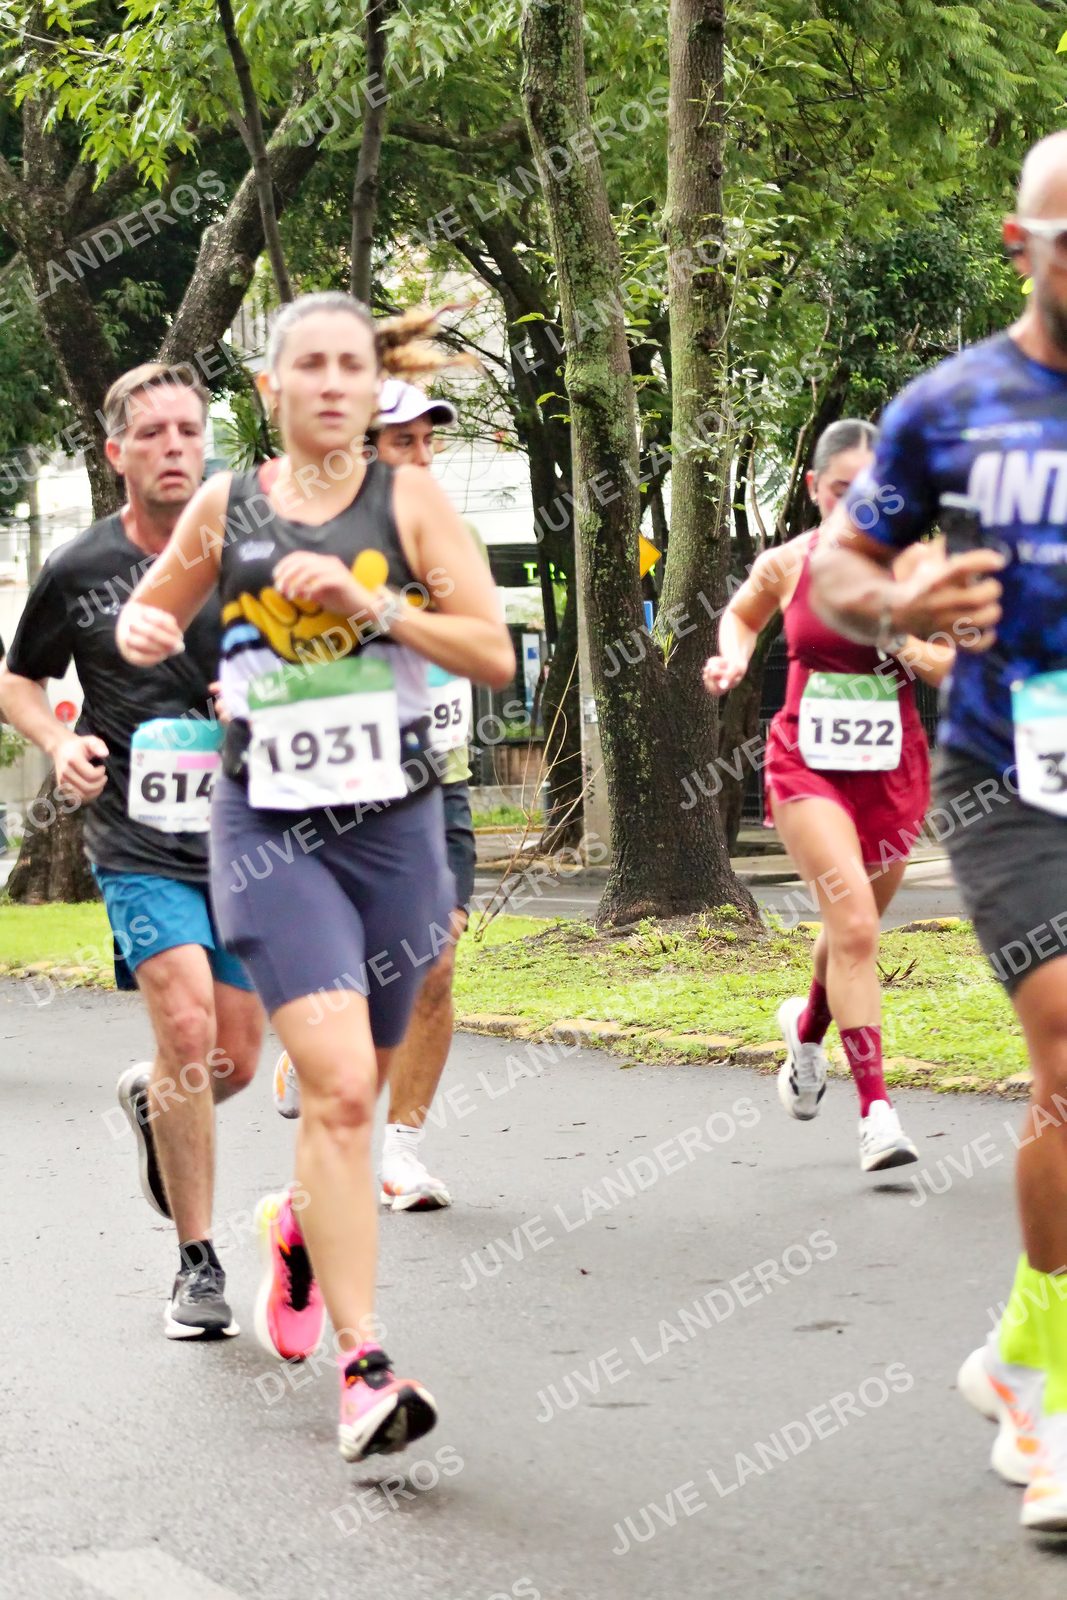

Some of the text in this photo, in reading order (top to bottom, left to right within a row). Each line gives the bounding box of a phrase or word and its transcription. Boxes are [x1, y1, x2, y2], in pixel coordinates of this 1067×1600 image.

[423, 698, 463, 730] 93
[811, 717, 895, 746] 1522
[260, 722, 383, 774] 1931
[141, 771, 215, 804] 614
